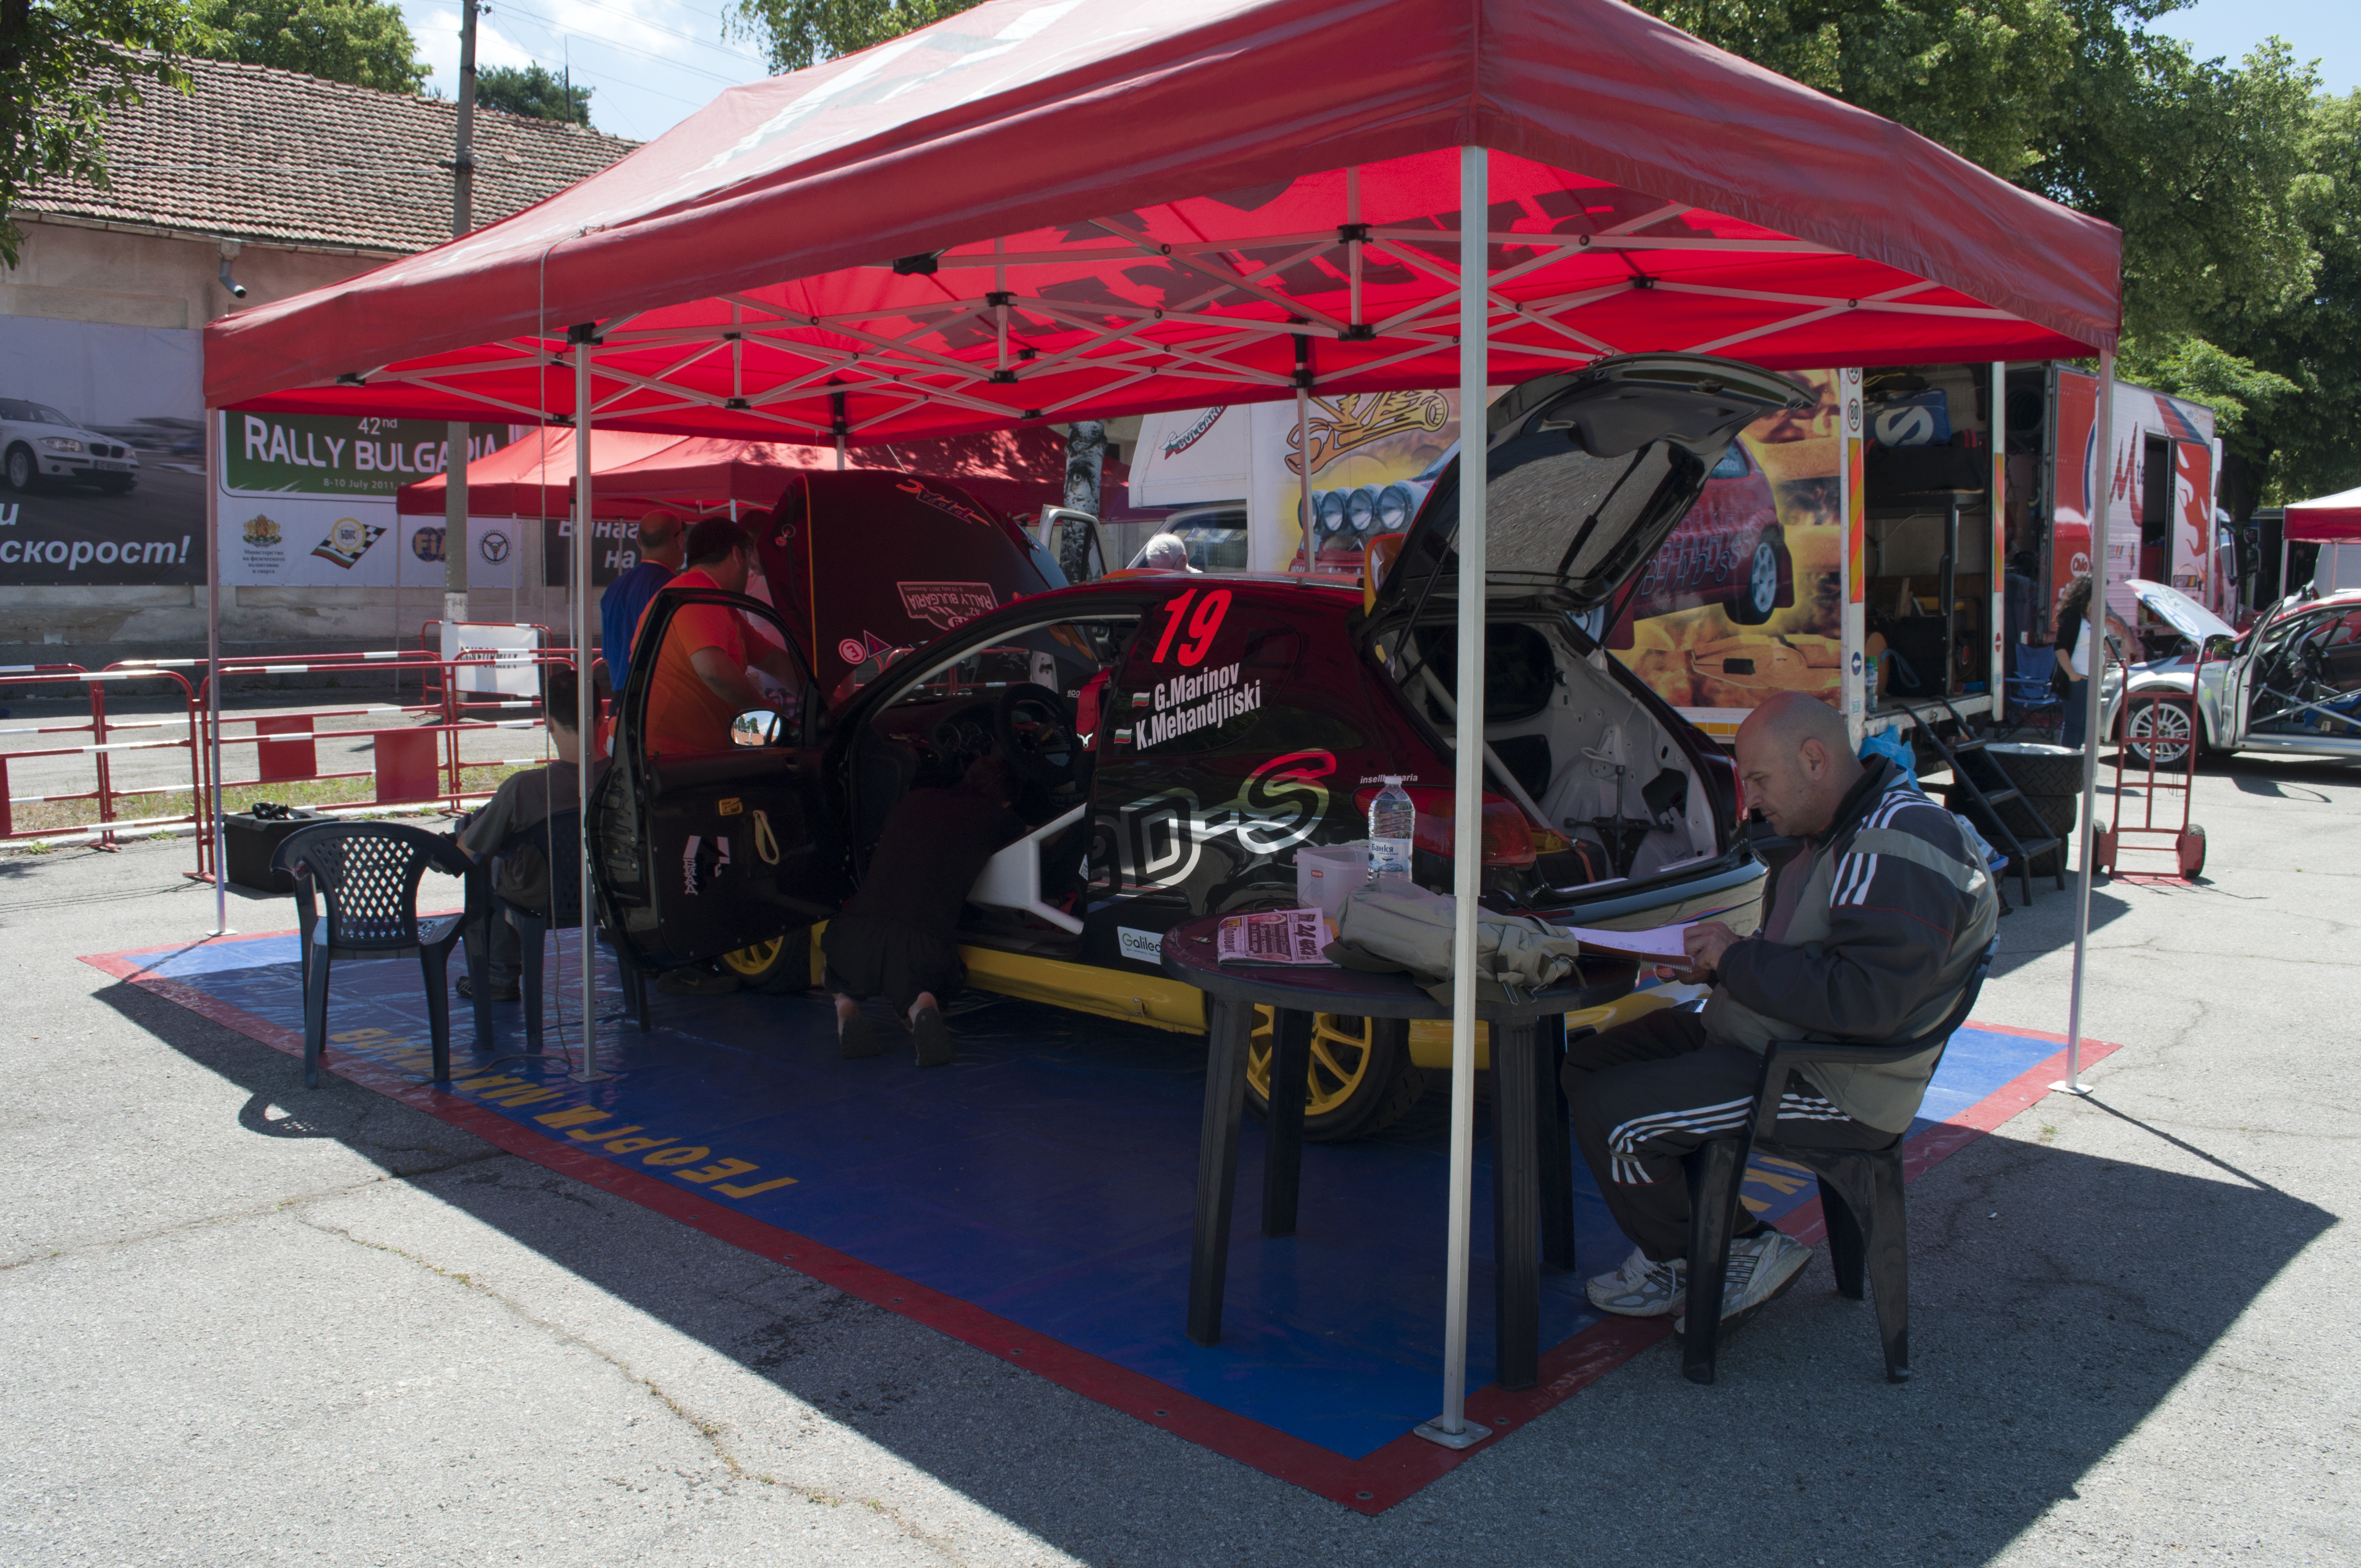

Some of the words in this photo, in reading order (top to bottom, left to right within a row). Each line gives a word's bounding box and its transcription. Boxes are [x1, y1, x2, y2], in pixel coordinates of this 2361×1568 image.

[357, 417, 398, 435] 42nd
[244, 415, 346, 469] RALLY
[355, 433, 497, 473] BULGAIA
[323, 478, 345, 487] 8-10
[349, 478, 368, 491] July
[0, 536, 191, 570] скорост!
[906, 593, 959, 610] BULGARIA
[960, 594, 994, 610] RALLY
[1152, 588, 1232, 667] 19
[1155, 662, 1239, 712] G.Marinov
[1372, 843, 1394, 853] Банкя
[1293, 923, 1316, 938] 24
[1299, 939, 1318, 955] часа
[533, 1104, 799, 1199] ГЕОРГИ
